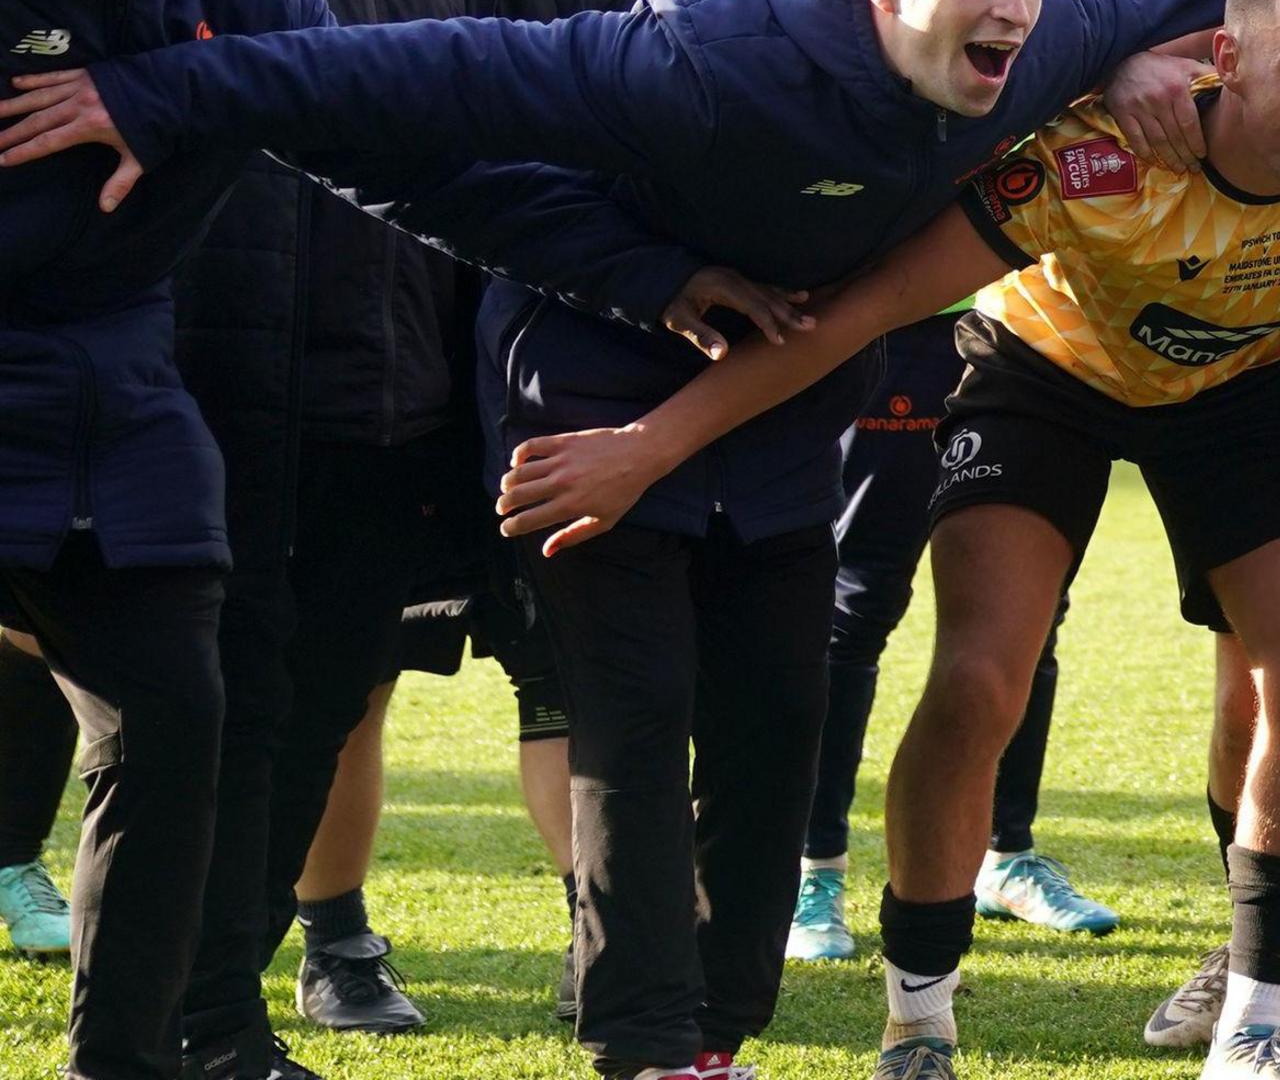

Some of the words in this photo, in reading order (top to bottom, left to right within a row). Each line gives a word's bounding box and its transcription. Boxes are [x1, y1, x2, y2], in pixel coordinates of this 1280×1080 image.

[1064, 150, 1077, 163] FA
[1075, 148, 1090, 189] Emirates
[1068, 164, 1082, 190] CUP
[1229, 257, 1273, 272] MAIDSTONE
[1223, 270, 1263, 284] EMIRATES
[1241, 279, 1277, 292] JANUARY
